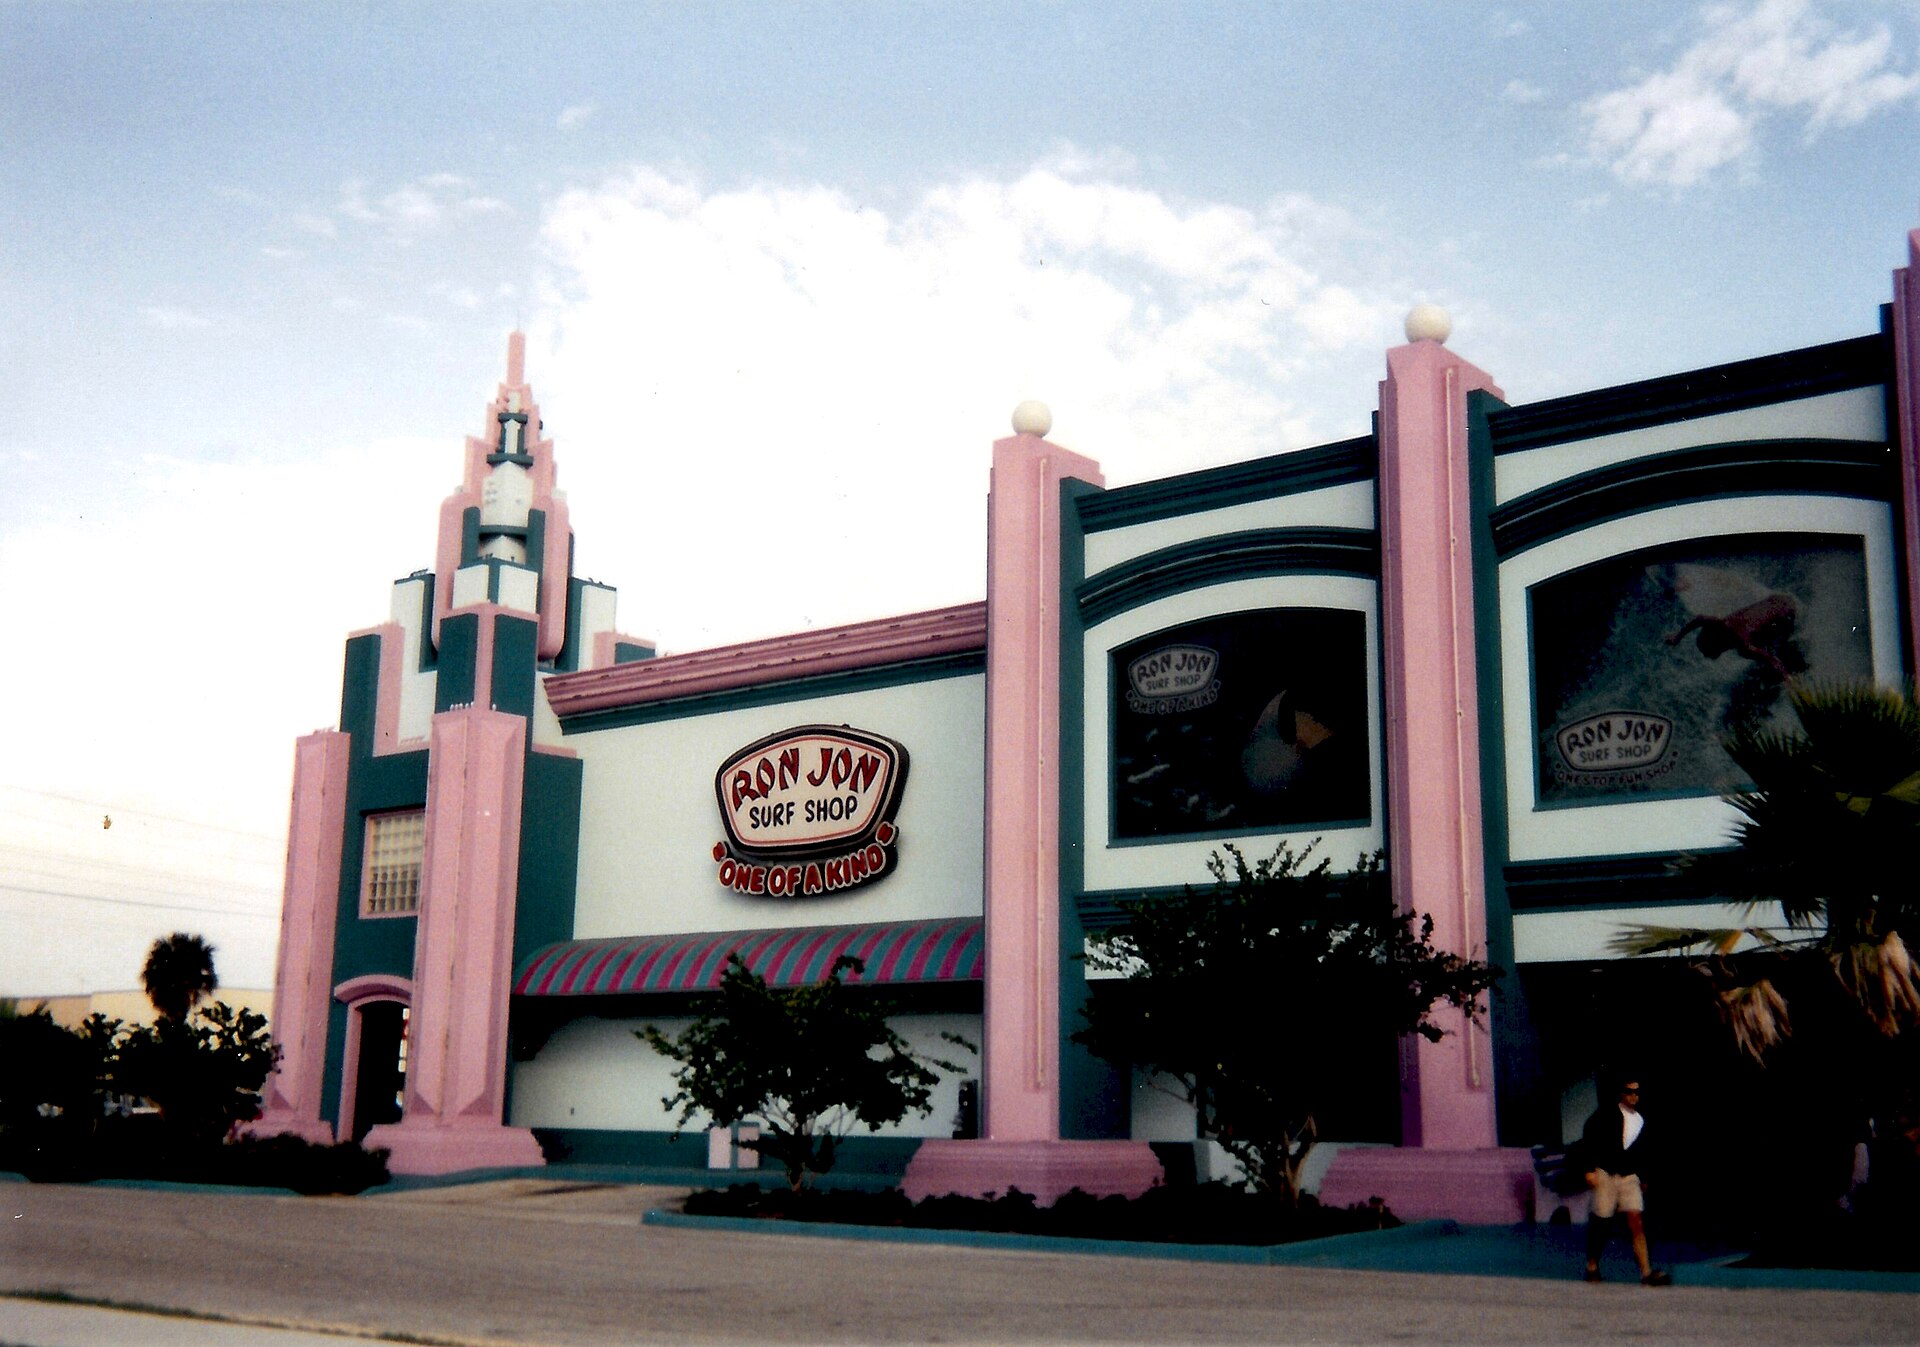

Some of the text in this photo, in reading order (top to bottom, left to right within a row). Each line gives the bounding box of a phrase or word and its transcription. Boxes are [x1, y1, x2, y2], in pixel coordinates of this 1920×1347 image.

[1137, 653, 1211, 683] RON JON
[1145, 674, 1201, 691] SURF SHOP
[1566, 719, 1665, 754] RON JON
[1579, 744, 1652, 763] SURF SHOP
[732, 747, 881, 812] RON JON
[750, 795, 858, 829] SURF SHOP
[719, 844, 886, 897] ONE OF A KIND
